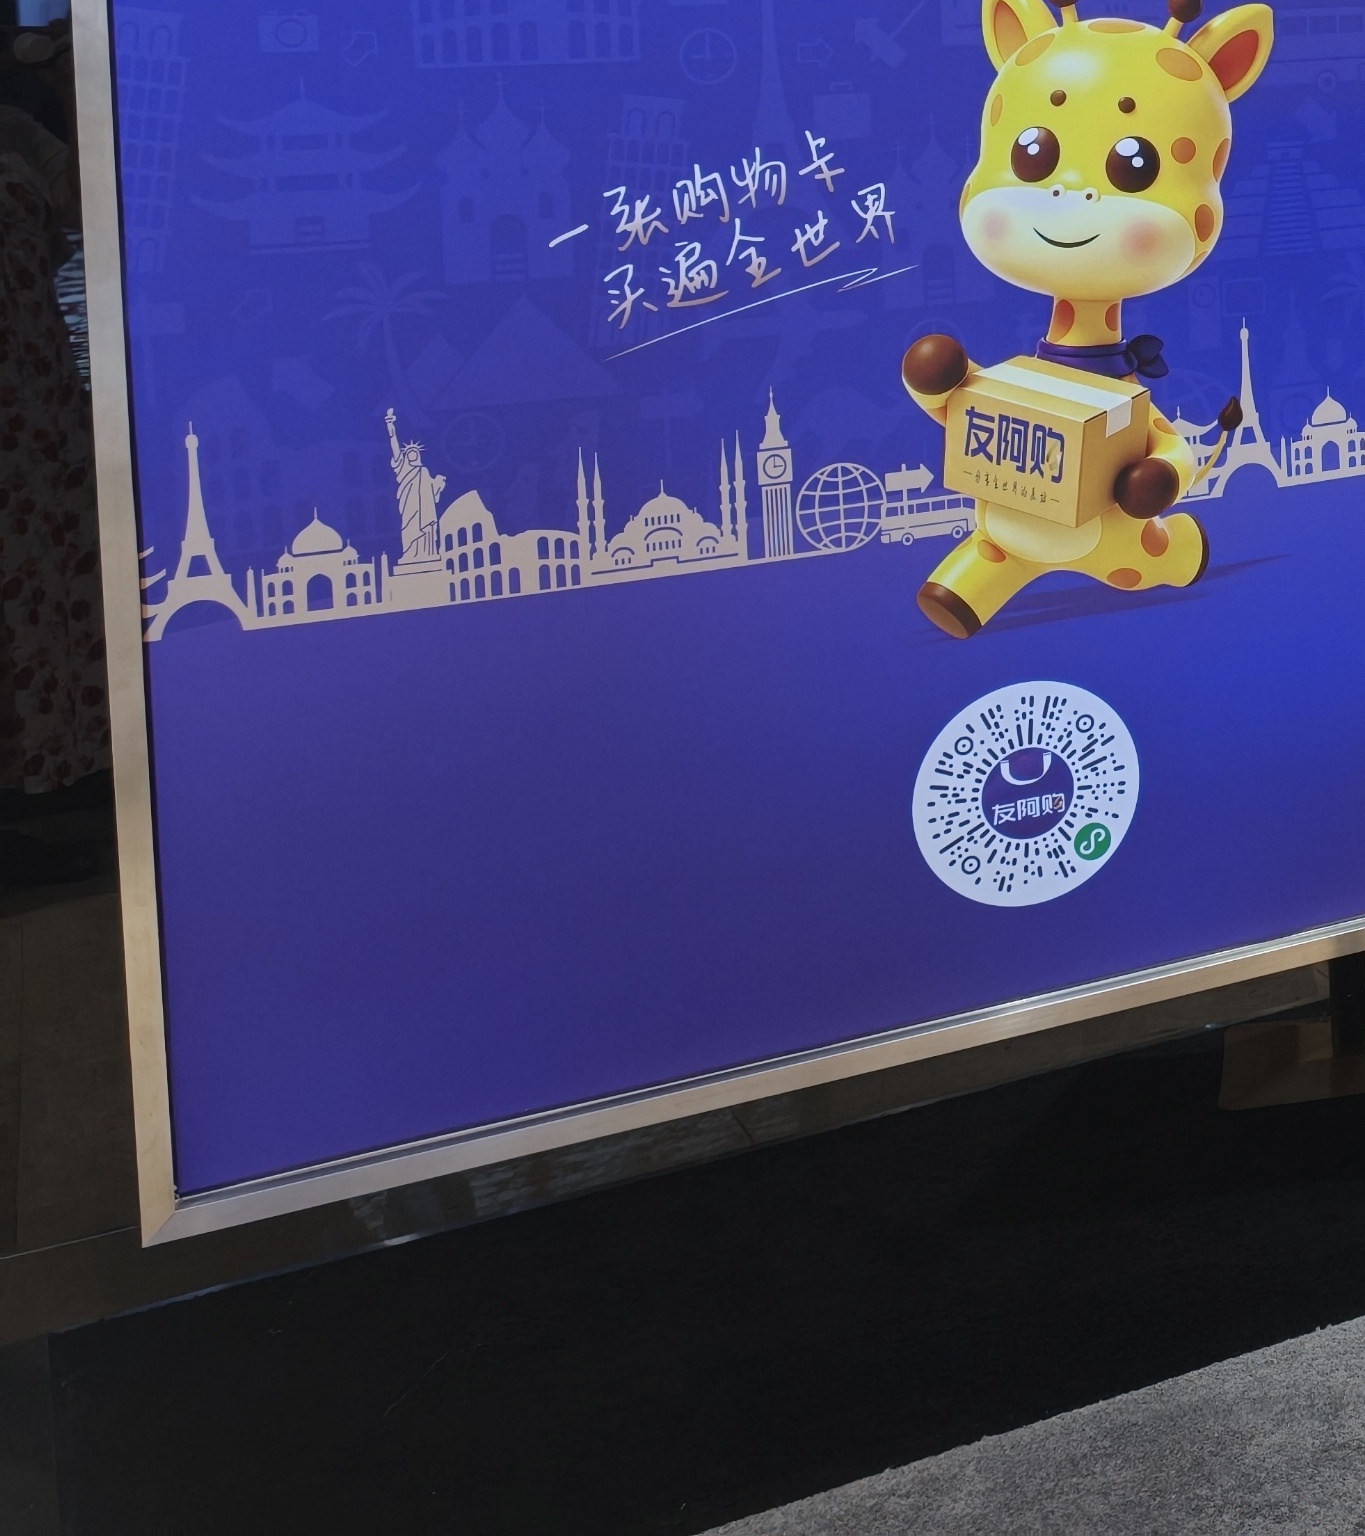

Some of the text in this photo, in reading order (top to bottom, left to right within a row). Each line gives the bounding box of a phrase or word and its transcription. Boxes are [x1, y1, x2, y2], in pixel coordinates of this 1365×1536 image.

[548, 130, 846, 252] 一张购物卡
[602, 182, 897, 329] 买遍全世界
[964, 406, 1065, 484] 友阿购
[992, 792, 1066, 826] 友阿购
